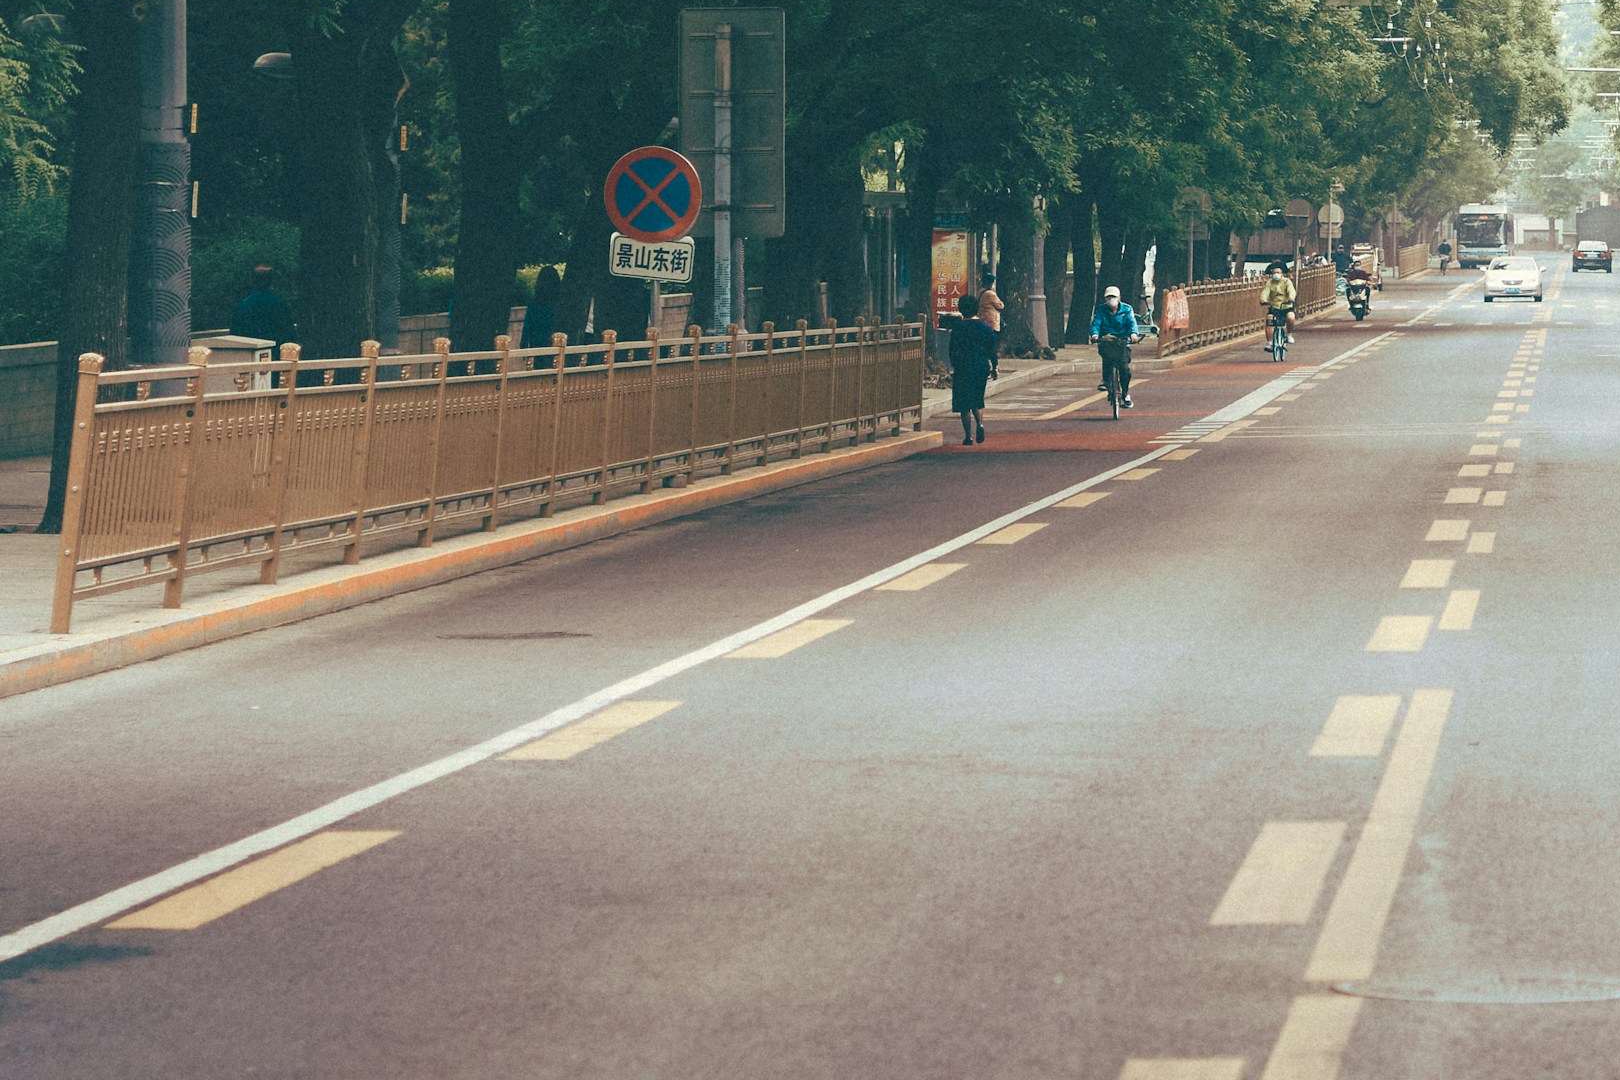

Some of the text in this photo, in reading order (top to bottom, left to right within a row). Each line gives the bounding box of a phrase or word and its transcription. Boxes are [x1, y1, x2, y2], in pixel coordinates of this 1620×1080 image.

[616, 243, 689, 274] 景山东街
[936, 246, 948, 313] 为中华民族
[950, 246, 961, 313] 为中国人民
